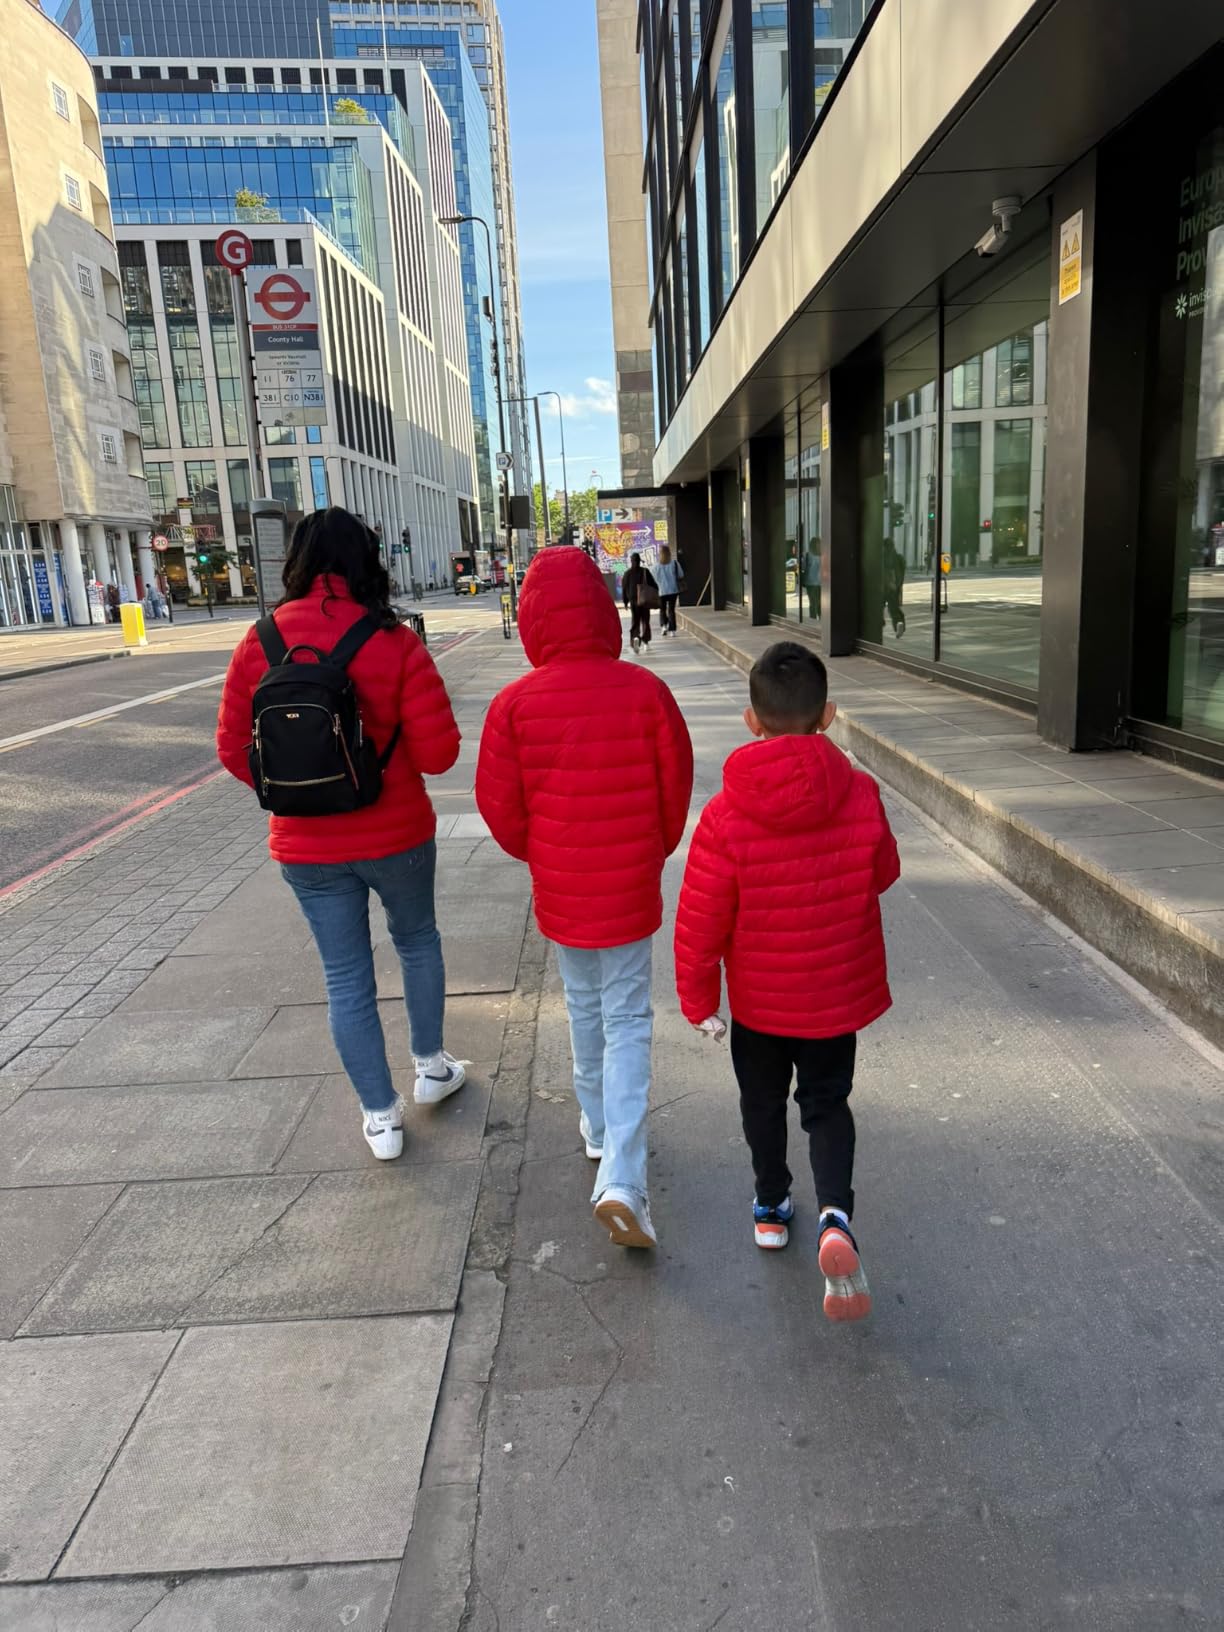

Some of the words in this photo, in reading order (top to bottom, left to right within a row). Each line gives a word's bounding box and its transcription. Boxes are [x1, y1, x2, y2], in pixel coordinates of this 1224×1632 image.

[223, 236, 246, 265] G
[306, 374, 316, 382] 77
[263, 394, 277, 402] 381
[284, 393, 300, 401] C10
[303, 393, 324, 401] N381
[601, 510, 611, 522] P
